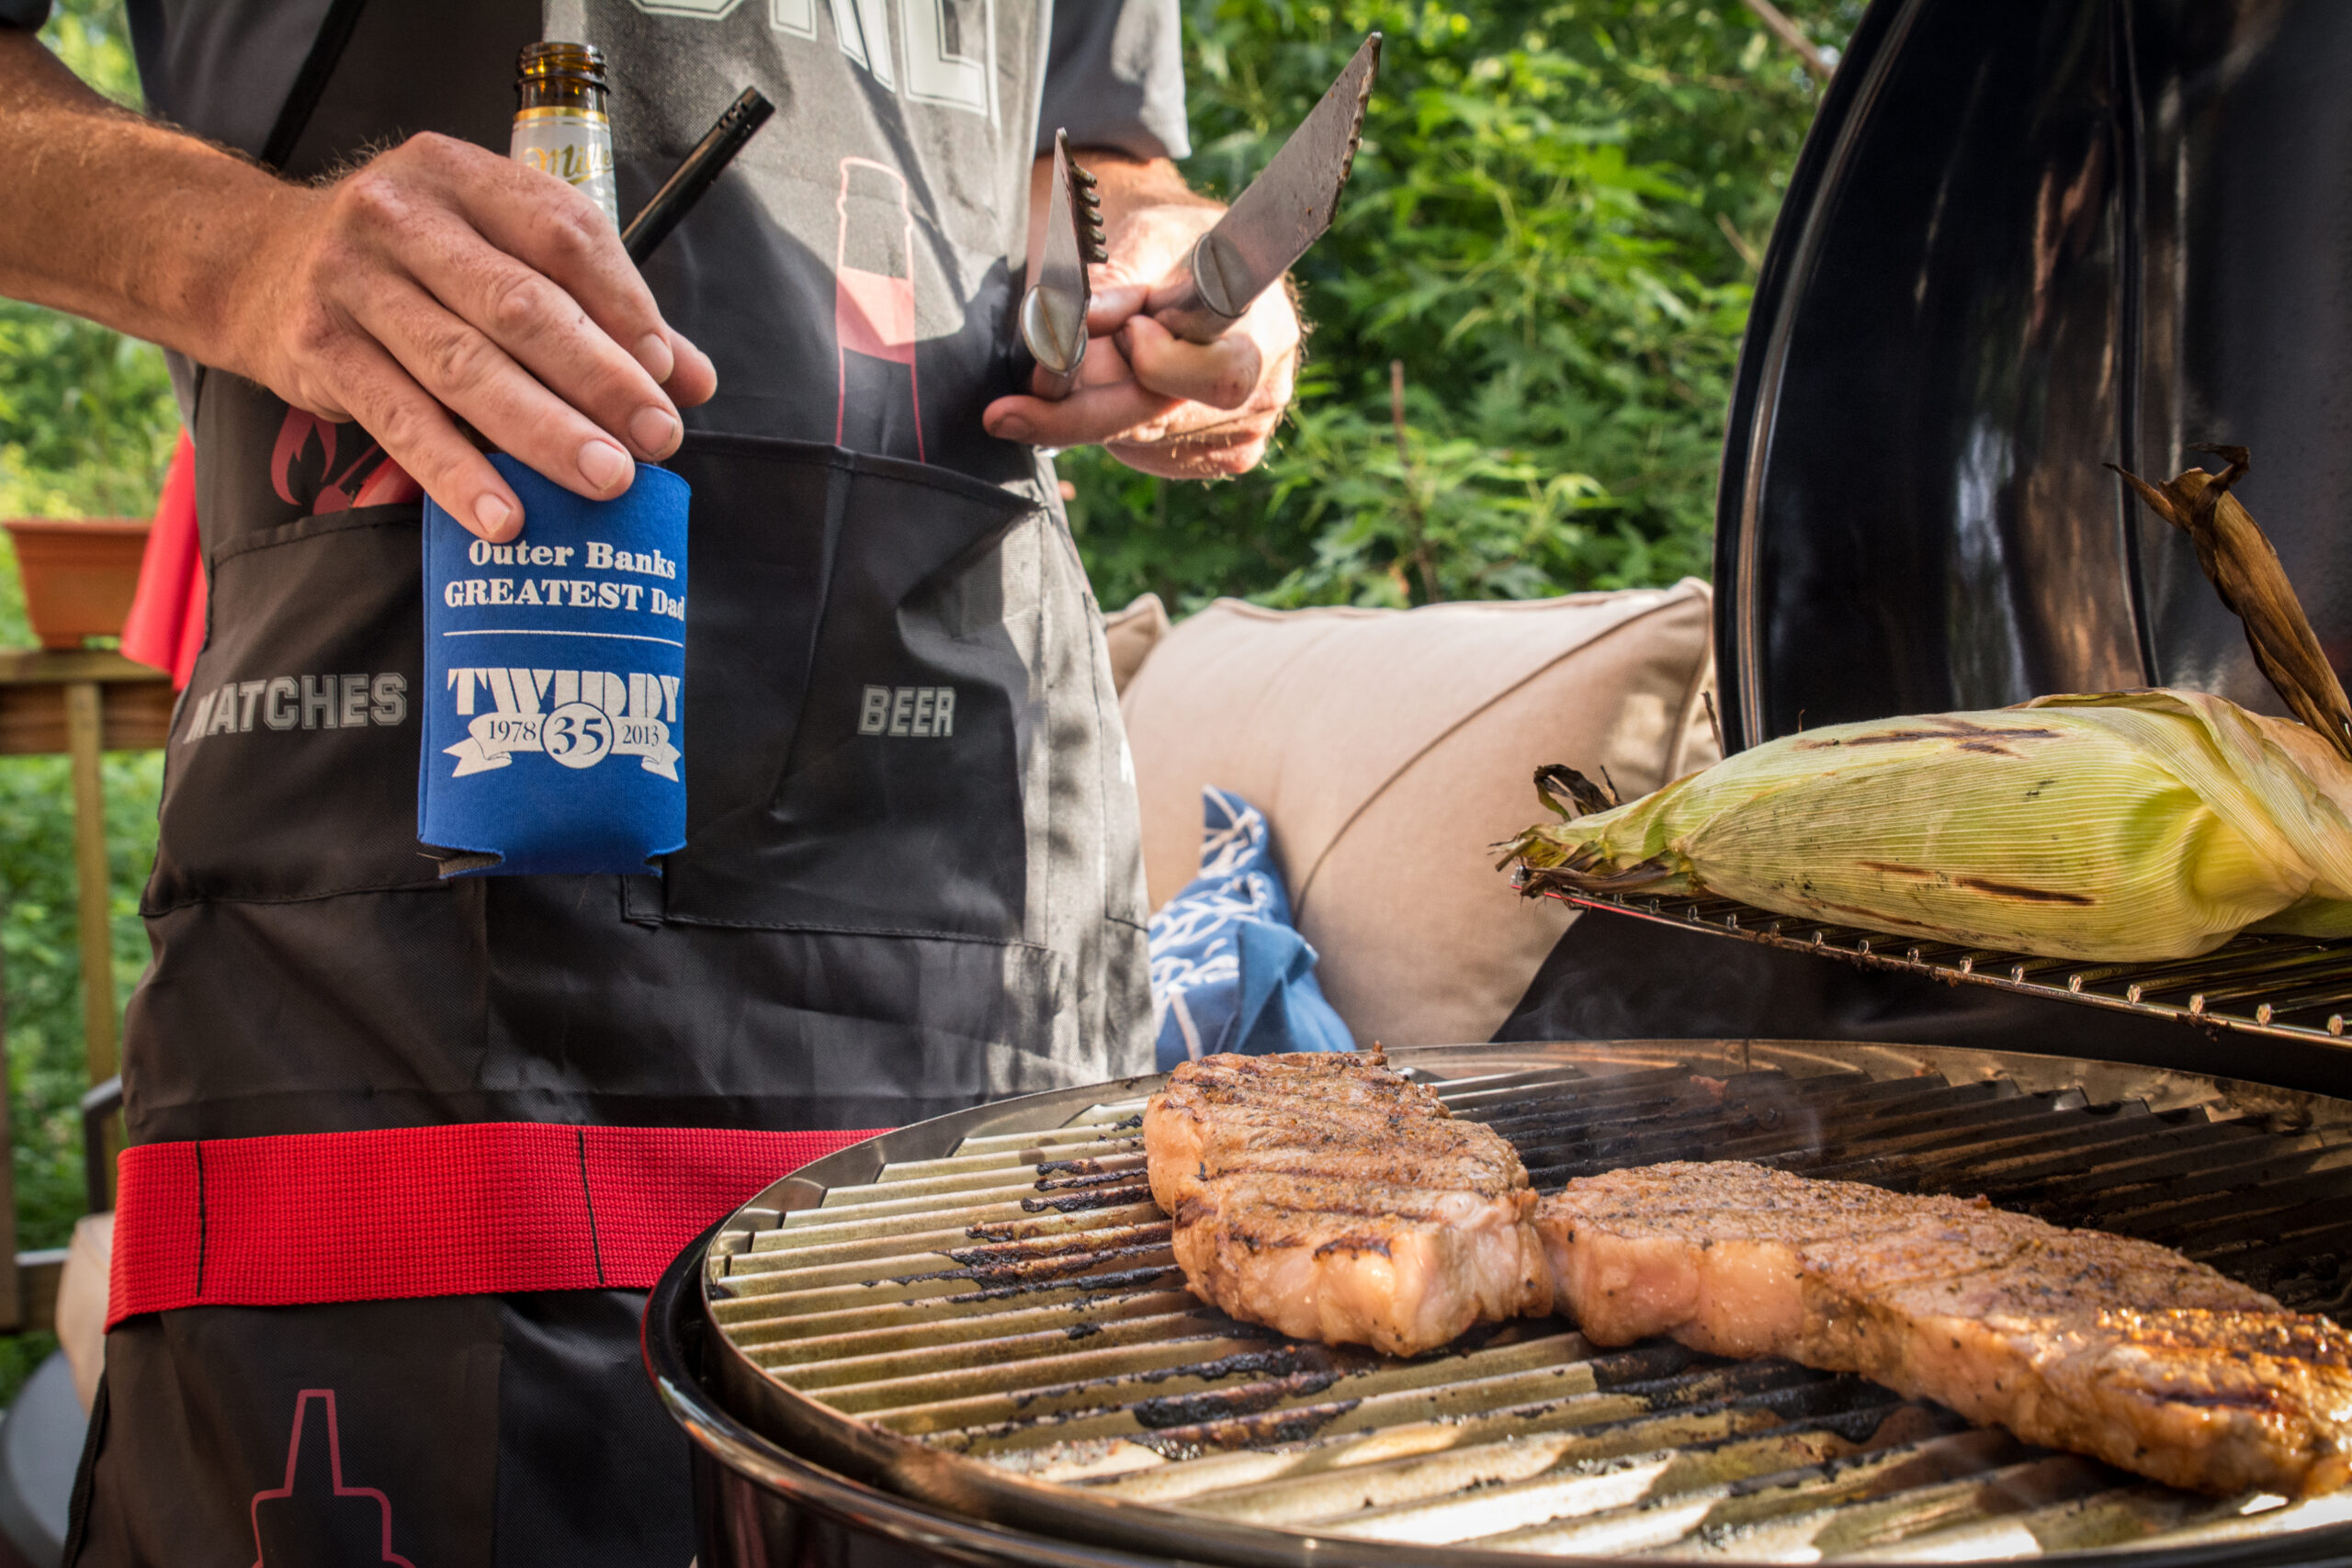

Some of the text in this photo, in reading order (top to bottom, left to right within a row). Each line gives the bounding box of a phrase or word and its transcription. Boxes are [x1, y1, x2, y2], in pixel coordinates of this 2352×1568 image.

[469, 539, 676, 580] Outer Banks
[444, 578, 684, 621] GREATEST Dad
[447, 668, 681, 723] TWIDDY
[857, 684, 957, 737] BEER
[488, 720, 537, 741] 1978
[552, 716, 605, 755] 35
[621, 724, 660, 747] 2013
